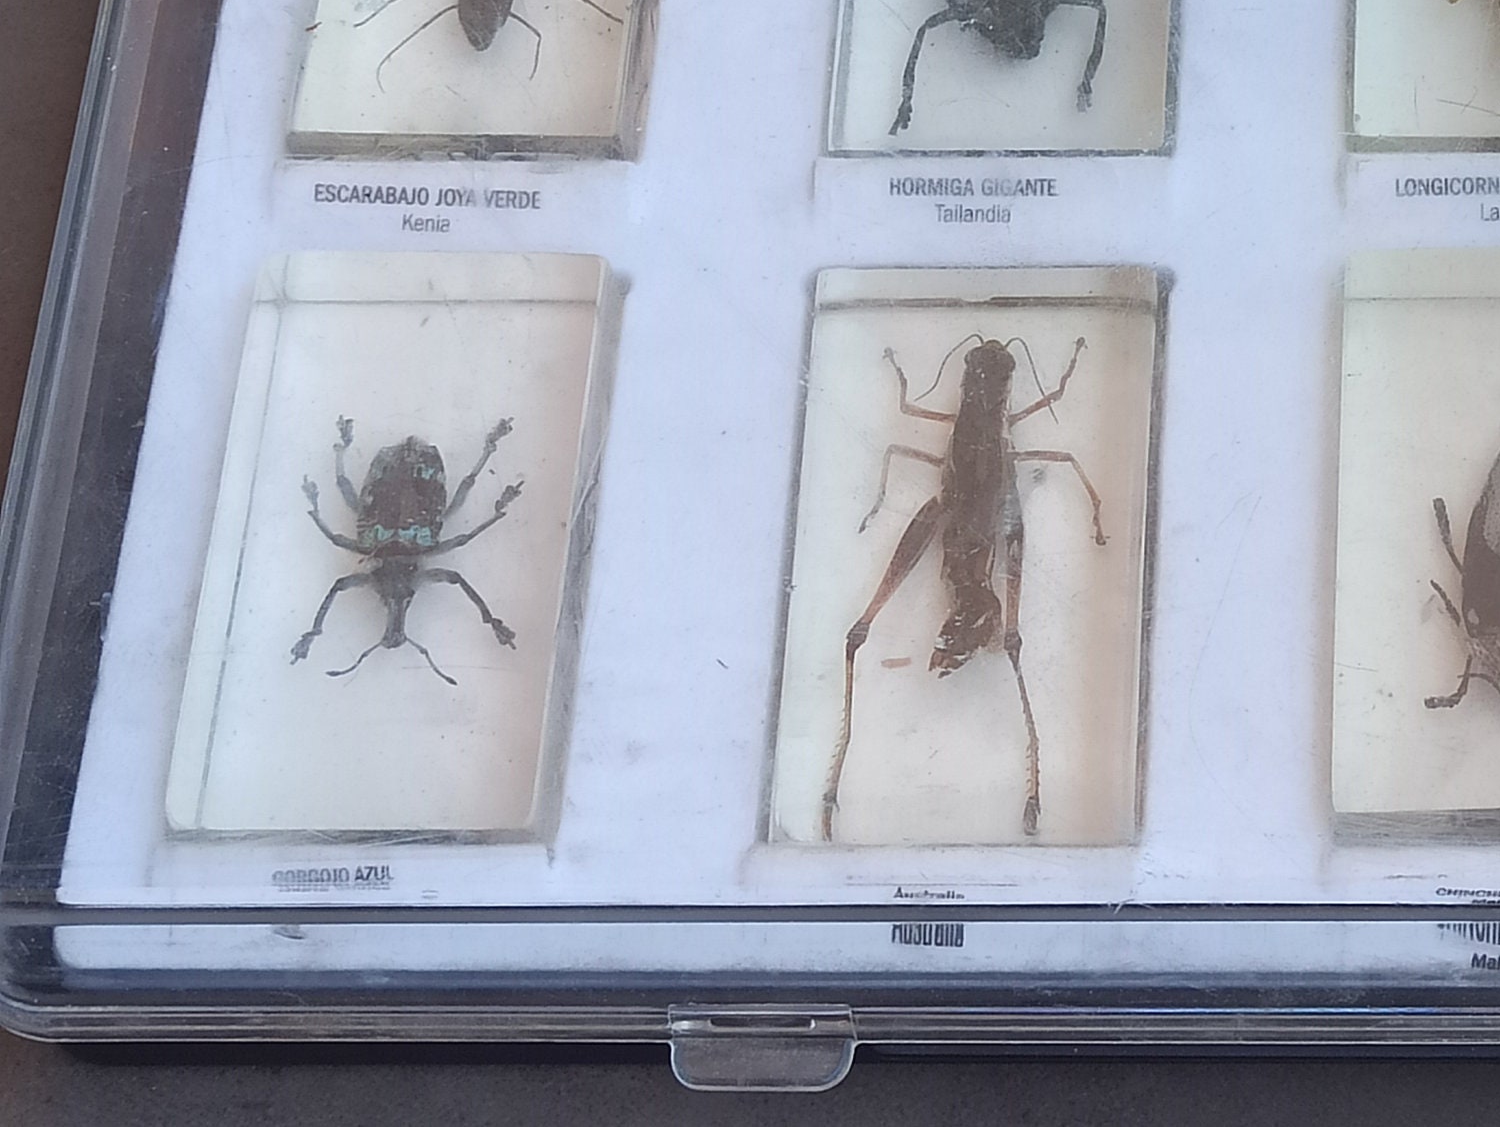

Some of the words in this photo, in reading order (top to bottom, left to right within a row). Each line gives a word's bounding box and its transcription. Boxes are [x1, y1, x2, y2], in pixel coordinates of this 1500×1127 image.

[314, 183, 430, 206] ESCARABAJO
[435, 187, 477, 208] JOYA
[484, 189, 541, 210] VERDE
[889, 177, 975, 197] HORMIGA
[980, 177, 1059, 197] GIGANTE
[401, 214, 451, 233] Kenia
[934, 204, 1012, 224] Tailandia
[354, 864, 395, 882] AZUL
